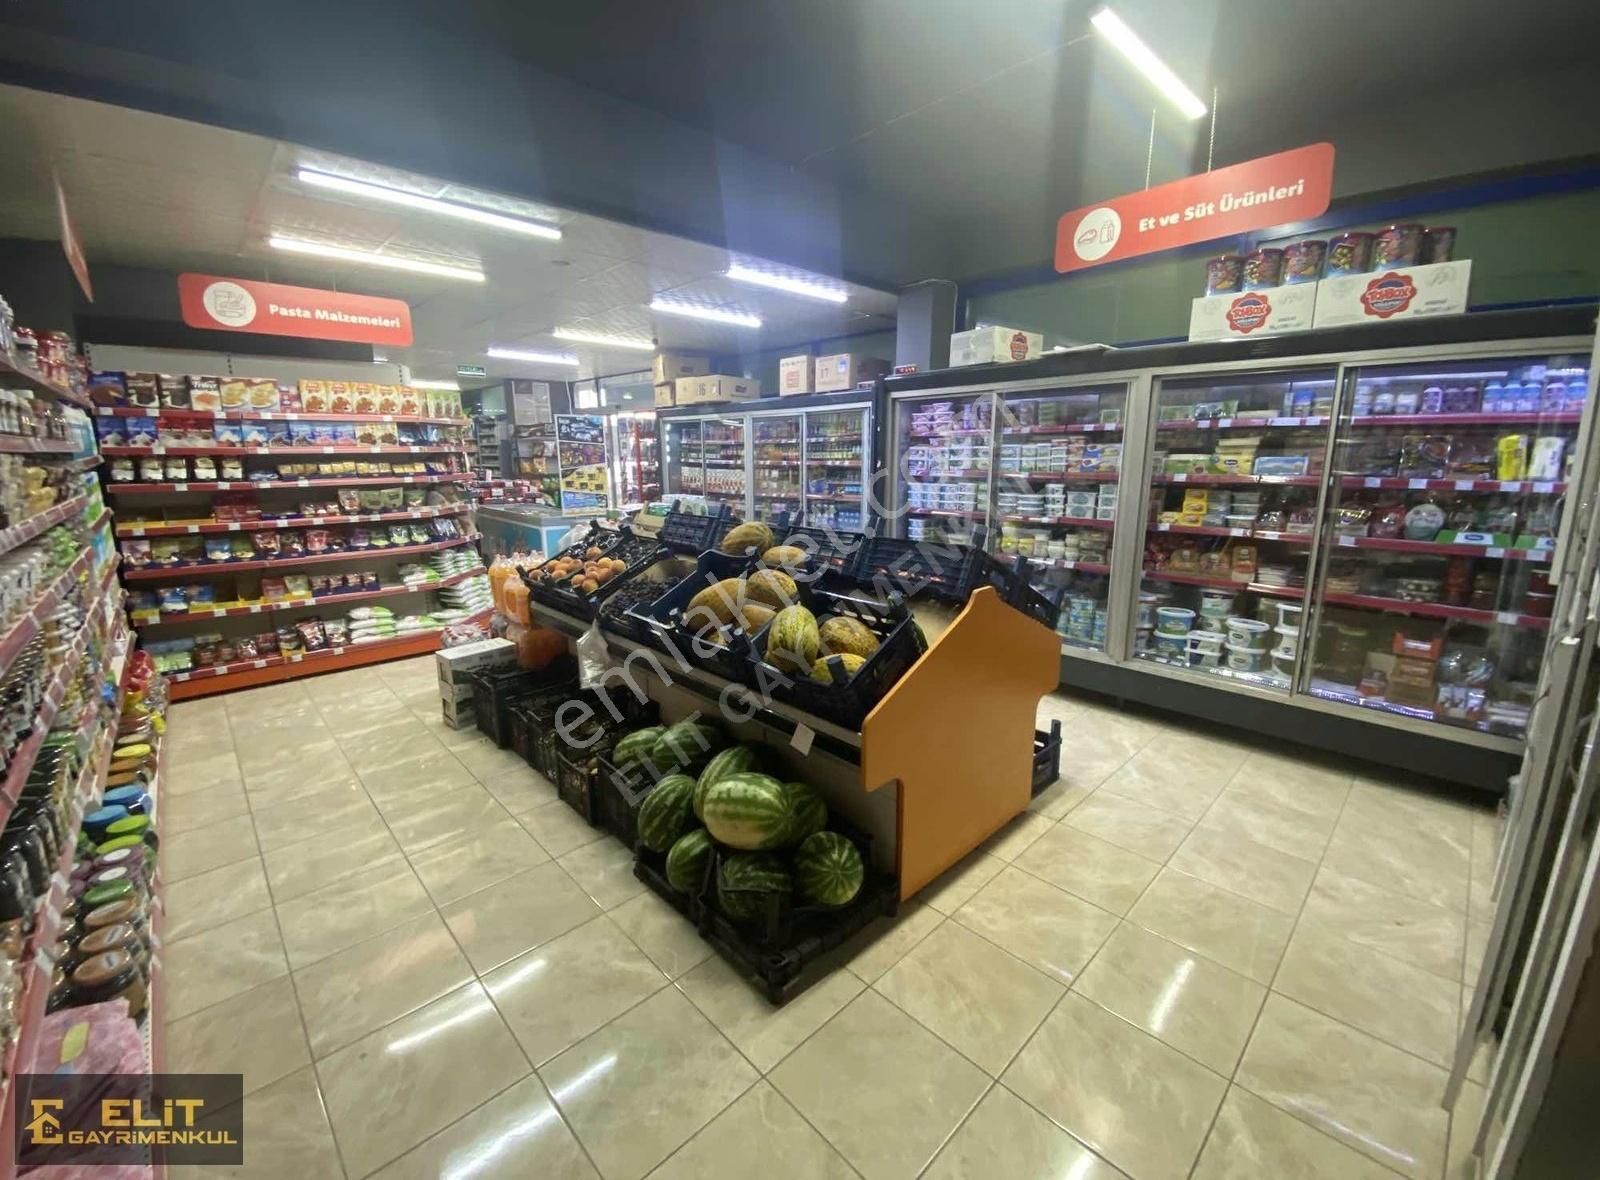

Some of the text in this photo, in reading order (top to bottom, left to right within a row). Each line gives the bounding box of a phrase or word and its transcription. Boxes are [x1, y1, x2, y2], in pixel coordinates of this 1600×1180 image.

[1138, 178, 1305, 233] Et ve Süt Ürünleri
[269, 303, 401, 328] Pasta Malzemeleri
